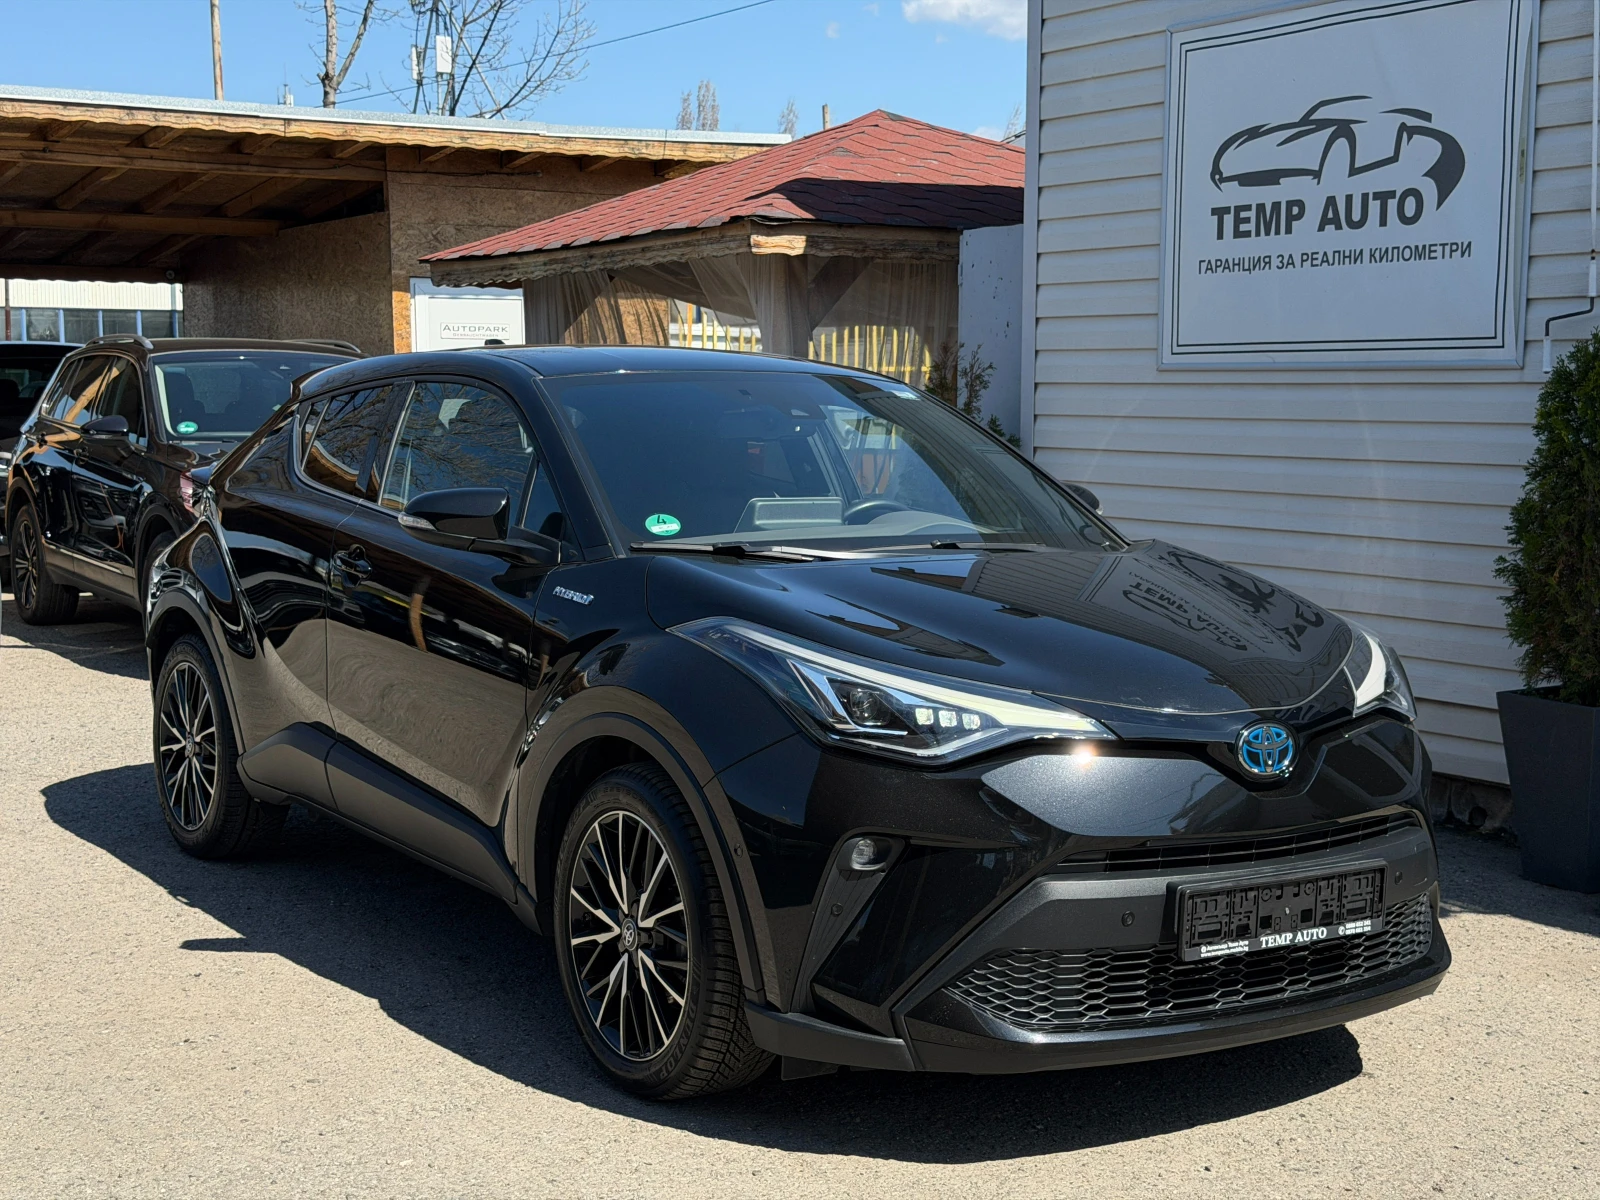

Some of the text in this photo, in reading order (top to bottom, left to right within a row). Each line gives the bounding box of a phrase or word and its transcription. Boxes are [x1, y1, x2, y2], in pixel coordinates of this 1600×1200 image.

[1210, 187, 1424, 241] TEMP AUTO
[1198, 240, 1473, 275] ГАРАНЦИЯ ЗА РЕАЛНИ КИЛОМЕТРИ
[442, 324, 508, 333] AUTOPARK
[1260, 933, 1293, 948] TEMP
[1294, 927, 1327, 943] AUTO
